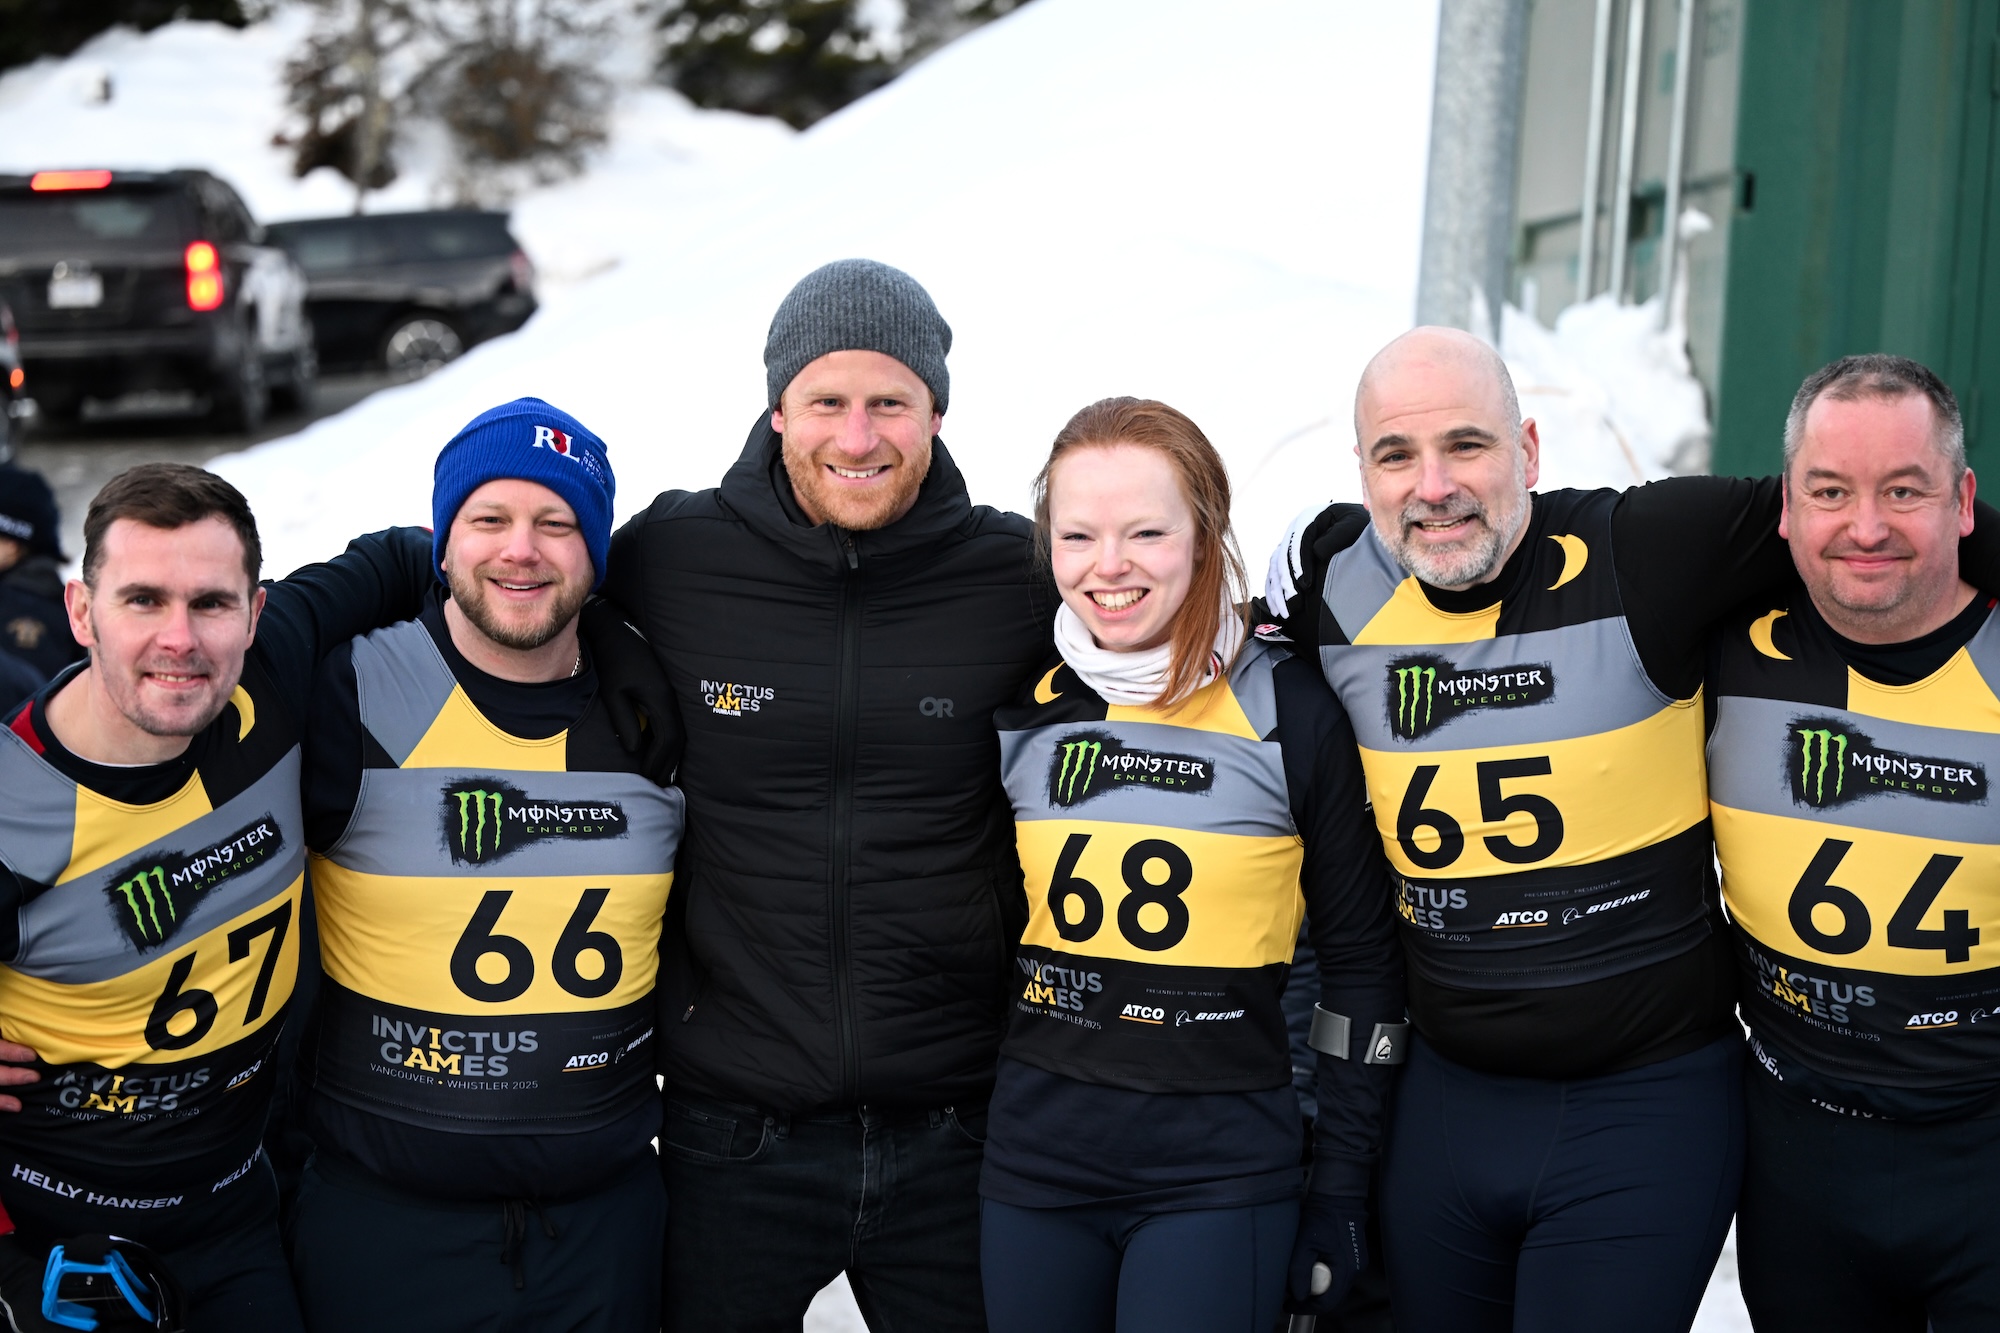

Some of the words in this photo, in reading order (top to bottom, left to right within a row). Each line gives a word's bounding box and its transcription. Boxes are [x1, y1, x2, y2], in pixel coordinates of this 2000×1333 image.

[700, 679, 775, 701] INVICTUS
[1437, 669, 1546, 697] MONSTER
[704, 693, 761, 712] GAMES
[918, 696, 955, 718] OR
[1454, 692, 1530, 706] ENERGY
[1101, 753, 1206, 778] MONSTER
[1113, 773, 1188, 786] ENERGY
[1851, 752, 1977, 787] MONSTER
[1869, 776, 1958, 795] ENERGY
[508, 804, 620, 823] MONSTER
[1396, 755, 1564, 869] 65
[526, 825, 605, 834] ENERGY
[171, 822, 275, 887] MONSTER
[194, 848, 266, 891] ENERGY
[1047, 833, 1193, 952] 68
[1391, 876, 1468, 910] ICTUS
[1494, 909, 1549, 925] ATCO
[1585, 889, 1651, 915] BOEING
[1524, 889, 1560, 898] PRESENTED
[1787, 837, 1980, 964] 64
[449, 888, 623, 1003] 66
[1448, 933, 1472, 943] 2025
[144, 899, 292, 1051] 67
[1022, 979, 1085, 1012] AMES
[1048, 1009, 1084, 1026] WHISTLER
[1083, 1018, 1102, 1031] 2025
[1121, 1003, 1165, 1020] ATCO
[1194, 1009, 1245, 1022] BOEING
[1906, 1010, 1959, 1026] ATCO
[372, 1014, 539, 1054] INVICTUS
[1803, 1014, 1852, 1037] WHISTLER
[1854, 1032, 1881, 1043] 2025
[226, 1059, 262, 1089] ATCO
[380, 1041, 509, 1078] GAMES
[564, 1051, 609, 1068] ATCO
[369, 1062, 434, 1086] VANCOUVER
[447, 1079, 509, 1091] WHISTLER
[512, 1079, 539, 1090] 2025
[58, 1085, 180, 1114] GAMES
[176, 1107, 201, 1119] 2025
[11, 1163, 83, 1200] HELLY
[86, 1191, 184, 1210] HANSEN
[211, 1154, 256, 1194] HELLY
